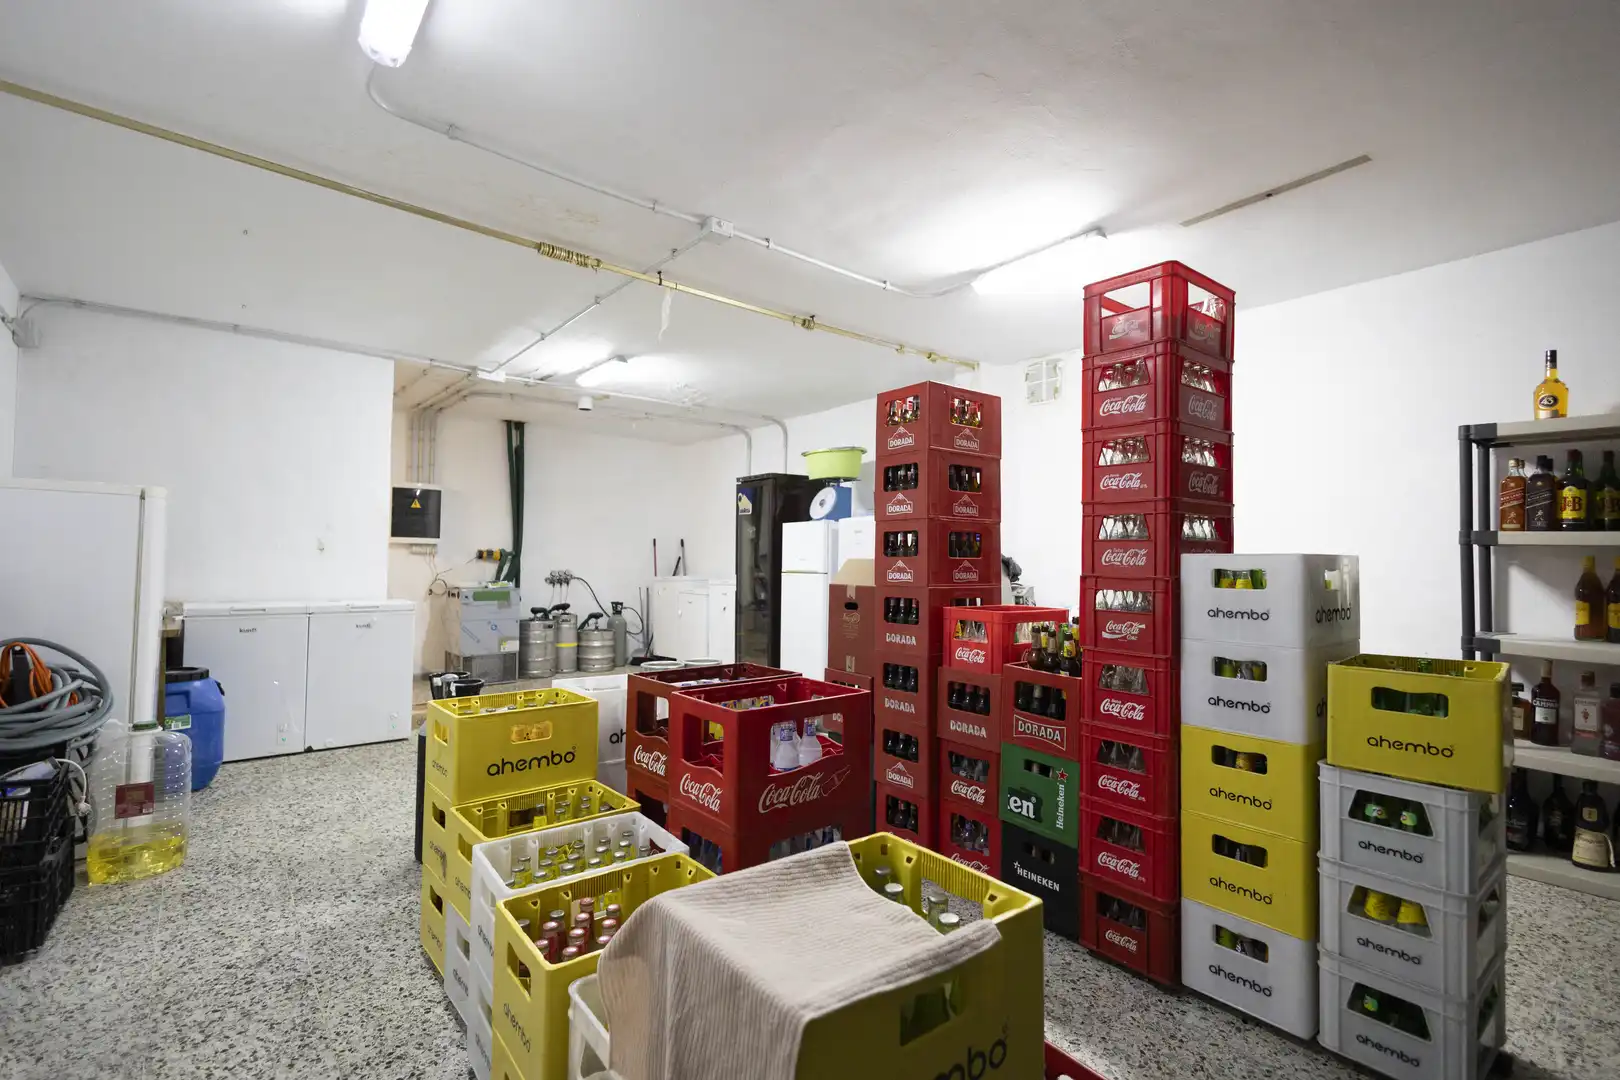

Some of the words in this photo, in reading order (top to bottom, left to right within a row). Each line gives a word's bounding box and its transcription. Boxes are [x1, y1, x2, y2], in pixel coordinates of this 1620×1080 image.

[889, 436, 913, 448] DORADA
[955, 438, 979, 449] DORADA
[888, 503, 912, 513] DORADA
[954, 505, 978, 516] DORADA
[888, 570, 912, 581] DORADA
[954, 571, 978, 581] DORADA
[1207, 606, 1270, 621] ahembo
[1315, 604, 1351, 624] ahembo
[885, 632, 917, 646] DORADA
[884, 698, 916, 714] DORADA
[1208, 695, 1270, 714] ahembo
[949, 719, 987, 739] DORADA
[1017, 720, 1062, 742] DORADA
[1367, 735, 1454, 758] ahembo
[486, 749, 577, 777] ahembo
[887, 772, 913, 786] DORADA
[1056, 783, 1065, 830] Heineken
[1209, 786, 1272, 811] ahembo
[1357, 839, 1423, 864] ahembo
[454, 876, 471, 900] ahemb
[1016, 862, 1061, 893] HEINEKEN
[1209, 875, 1273, 905] ahembo
[1356, 935, 1422, 966] ahembo
[1208, 963, 1273, 997] ahembo
[503, 1002, 532, 1053] ahembo
[1356, 1032, 1420, 1068] ahembo
